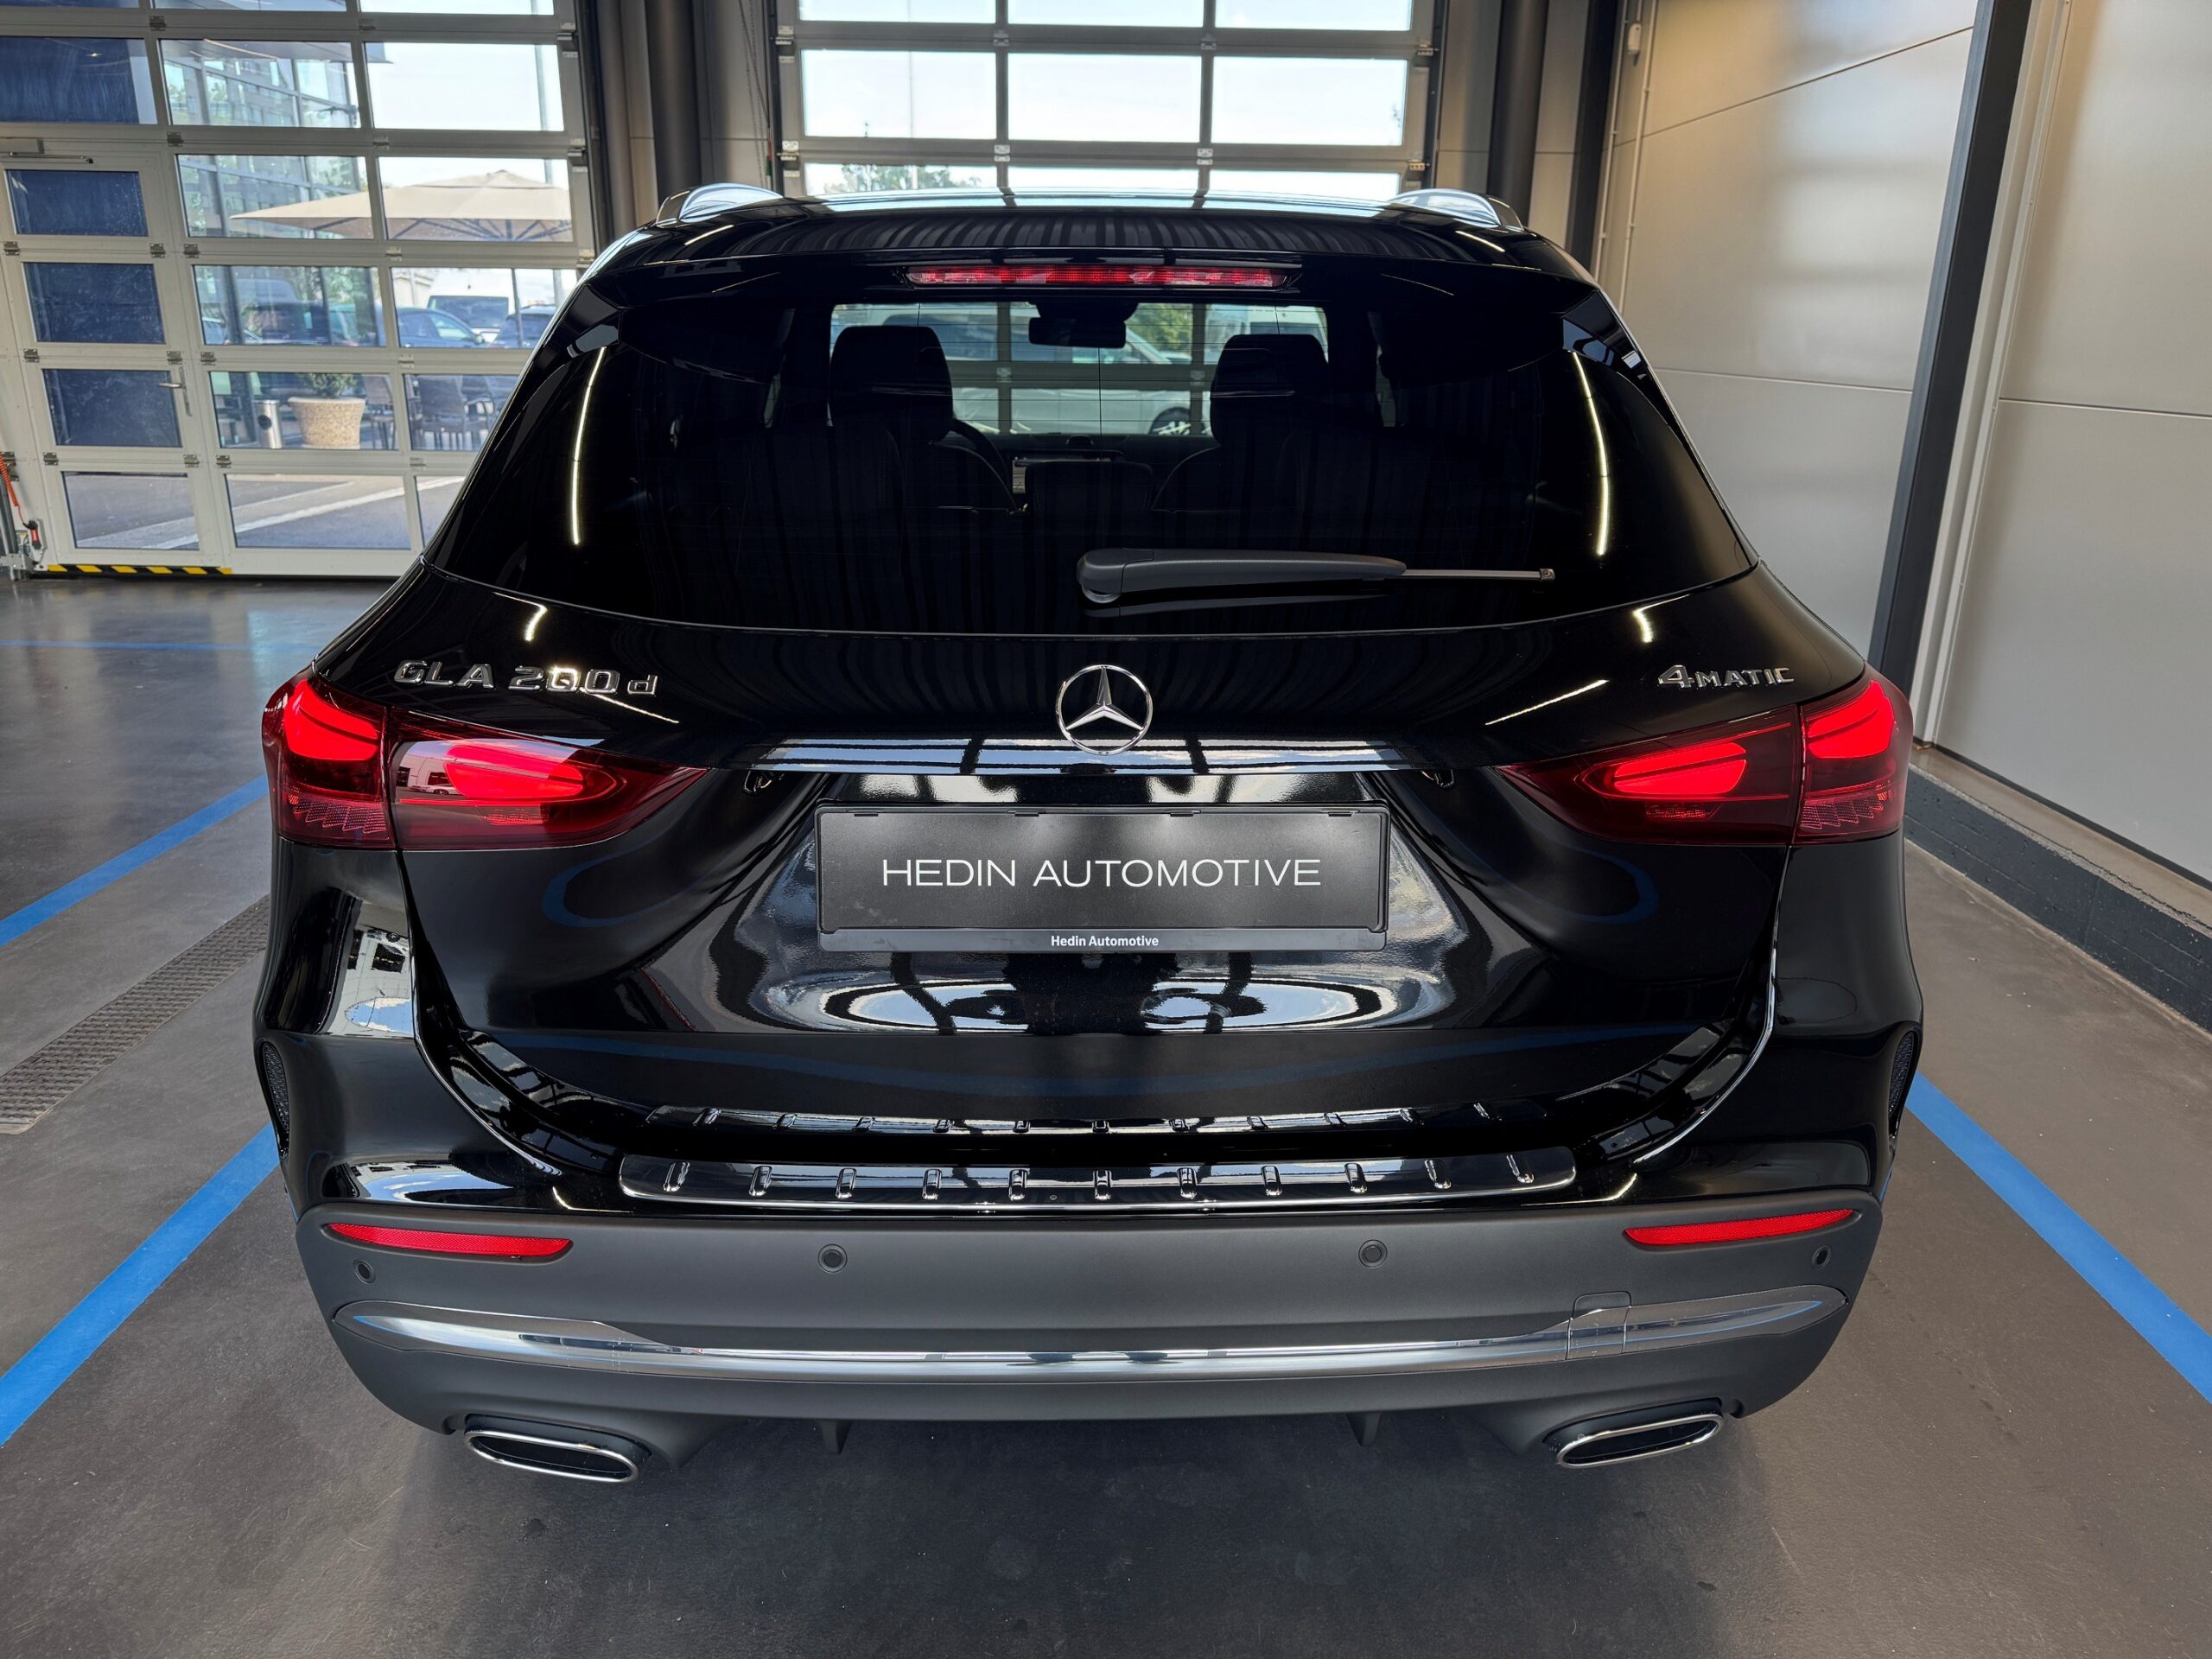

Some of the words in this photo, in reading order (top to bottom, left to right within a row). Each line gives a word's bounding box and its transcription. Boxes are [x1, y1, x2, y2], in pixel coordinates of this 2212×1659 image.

[393, 659, 494, 690] GLA
[508, 663, 620, 694] 200
[626, 674, 658, 696] d
[1657, 664, 1795, 688] 4MATIC
[882, 859, 1016, 887] HEDIN
[1033, 858, 1322, 887] AUTOMOTIVE
[1051, 935, 1086, 947] Hedin
[1088, 935, 1160, 947] Automotive
